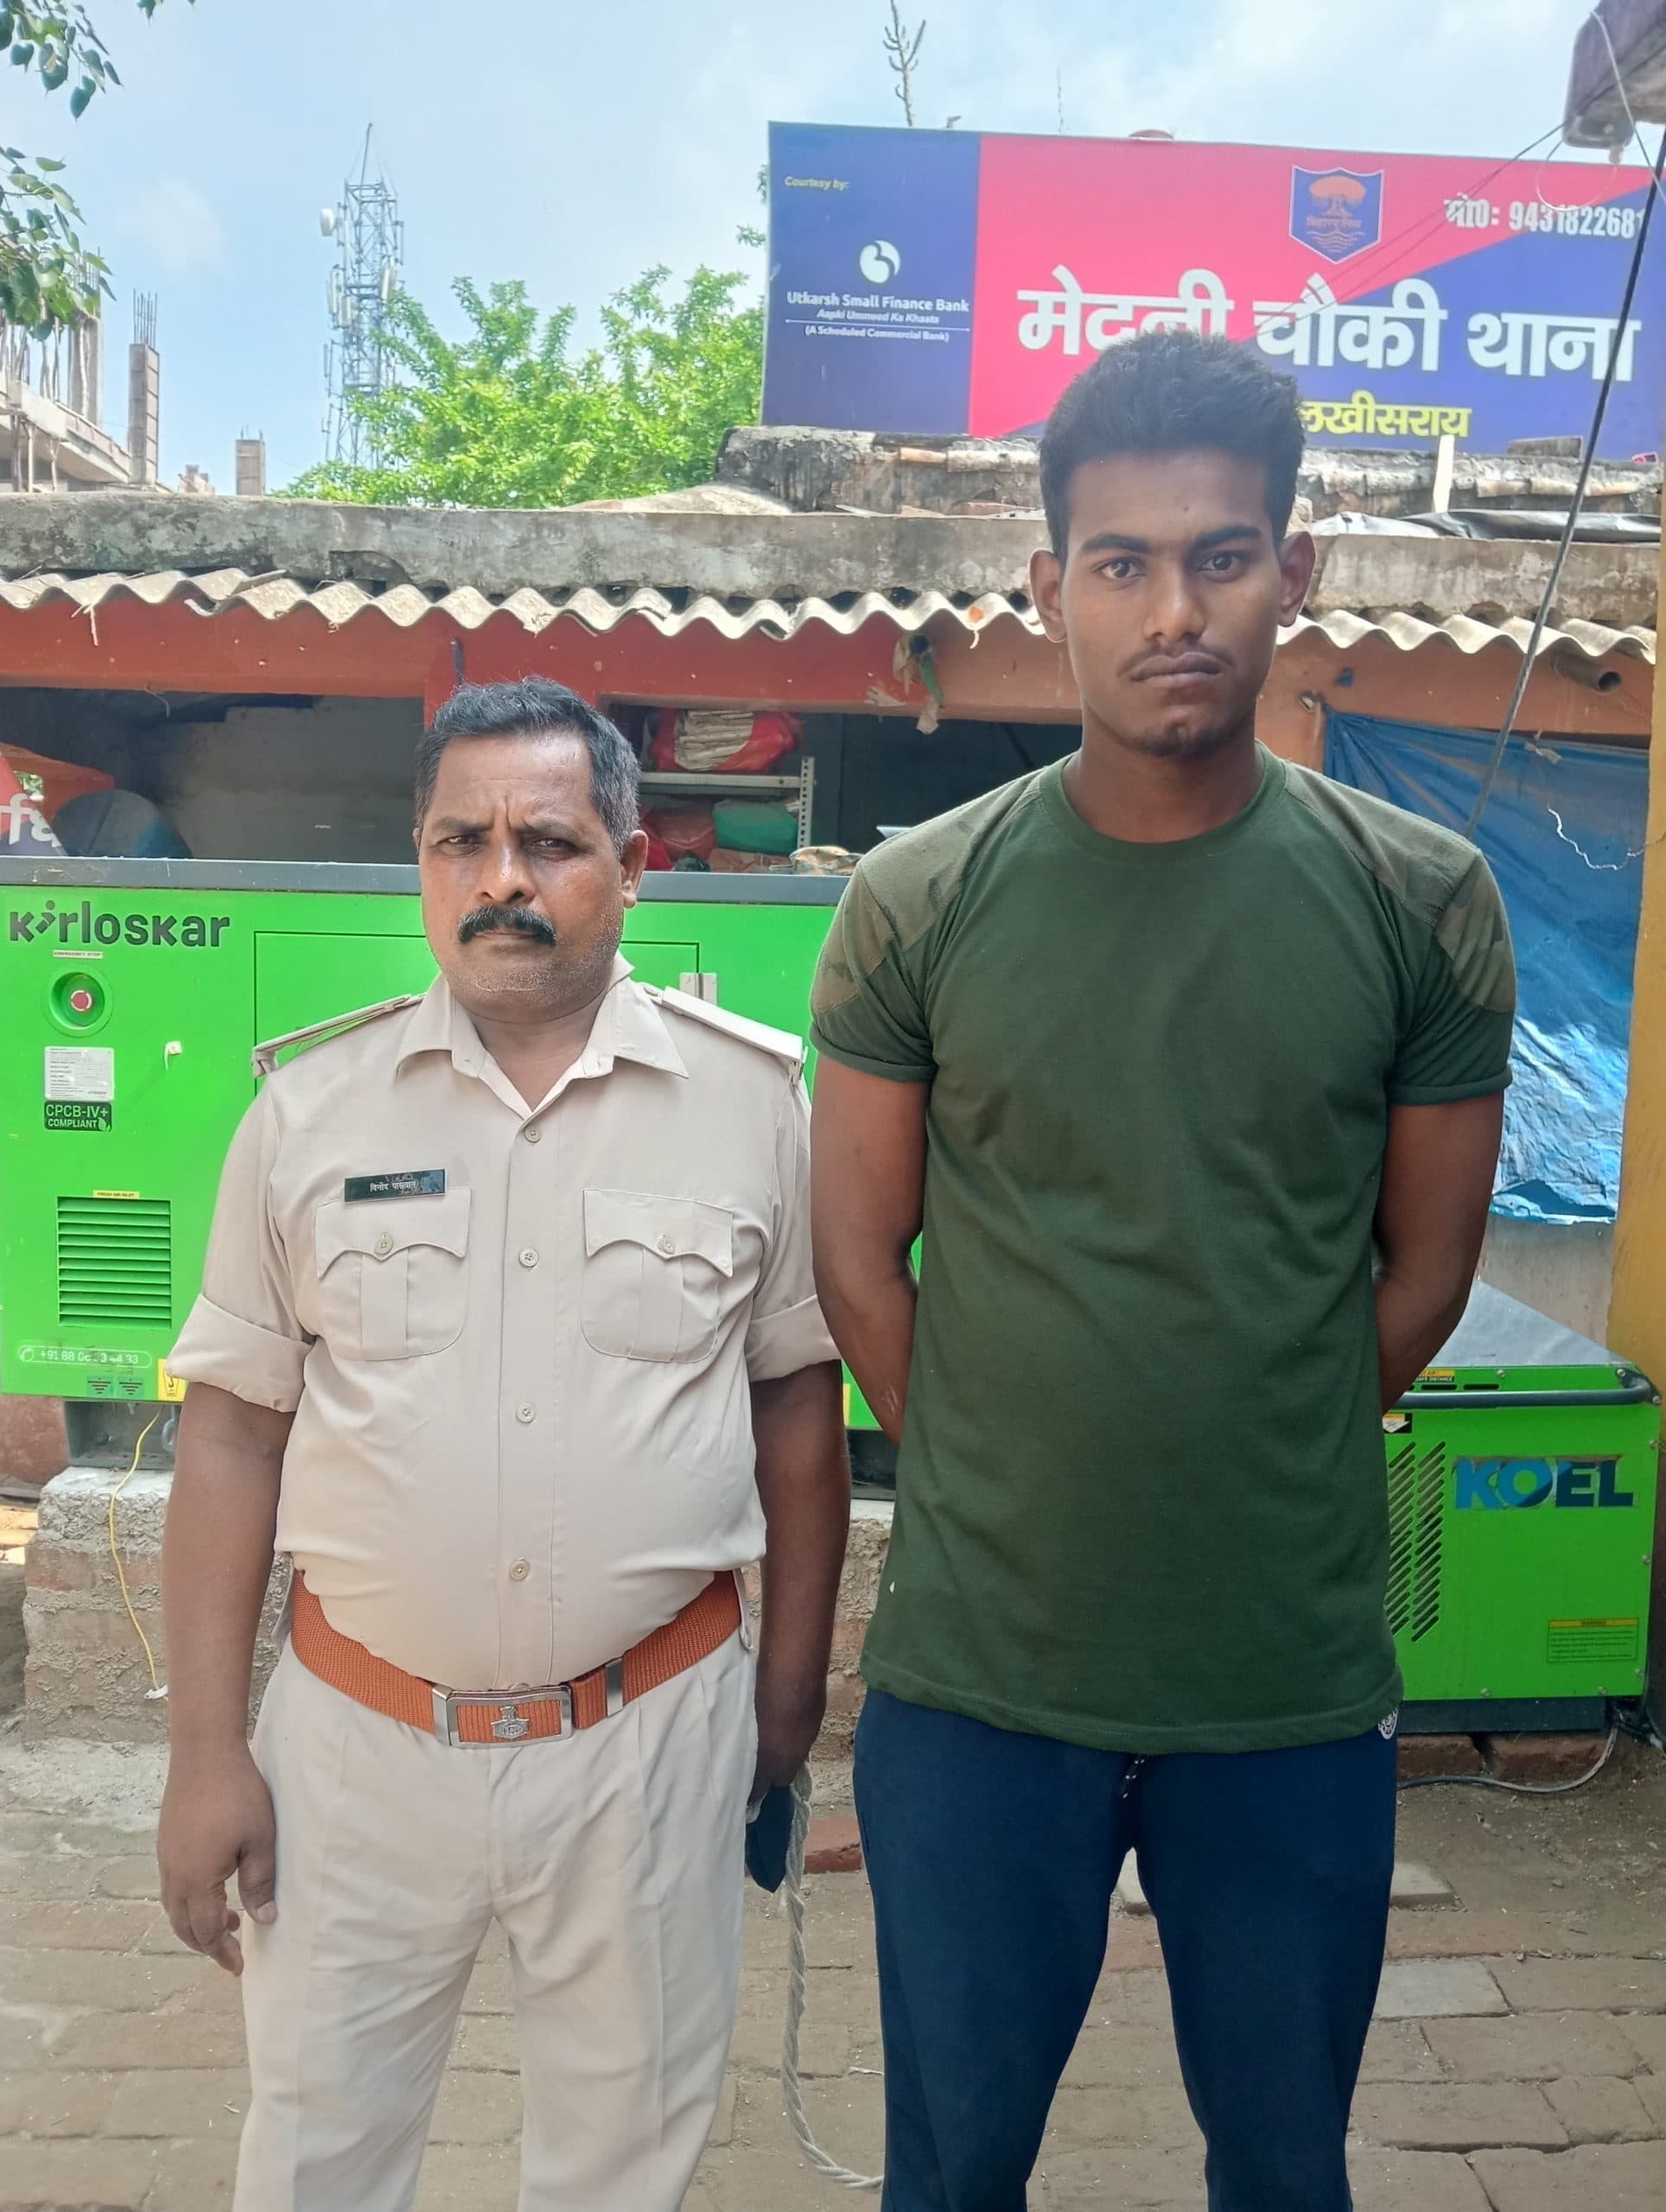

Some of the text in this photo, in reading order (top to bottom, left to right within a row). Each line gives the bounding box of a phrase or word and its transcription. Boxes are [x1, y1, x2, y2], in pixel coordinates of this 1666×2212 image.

[785, 175, 830, 190] Courtesy
[786, 290, 970, 312] Utkarsh Small Finance Bank
[817, 326, 866, 337] Scheduled
[867, 328, 921, 340] Commercial
[922, 331, 950, 343] Bank)
[1252, 272, 1448, 371] चौकी
[1467, 311, 1643, 382] थाना
[46, 1104, 109, 1118] CPCB-IV+
[48, 1118, 98, 1128] COMPLIANT
[40, 1350, 59, 1360] +91
[1455, 1457, 1634, 1510] KOEL
